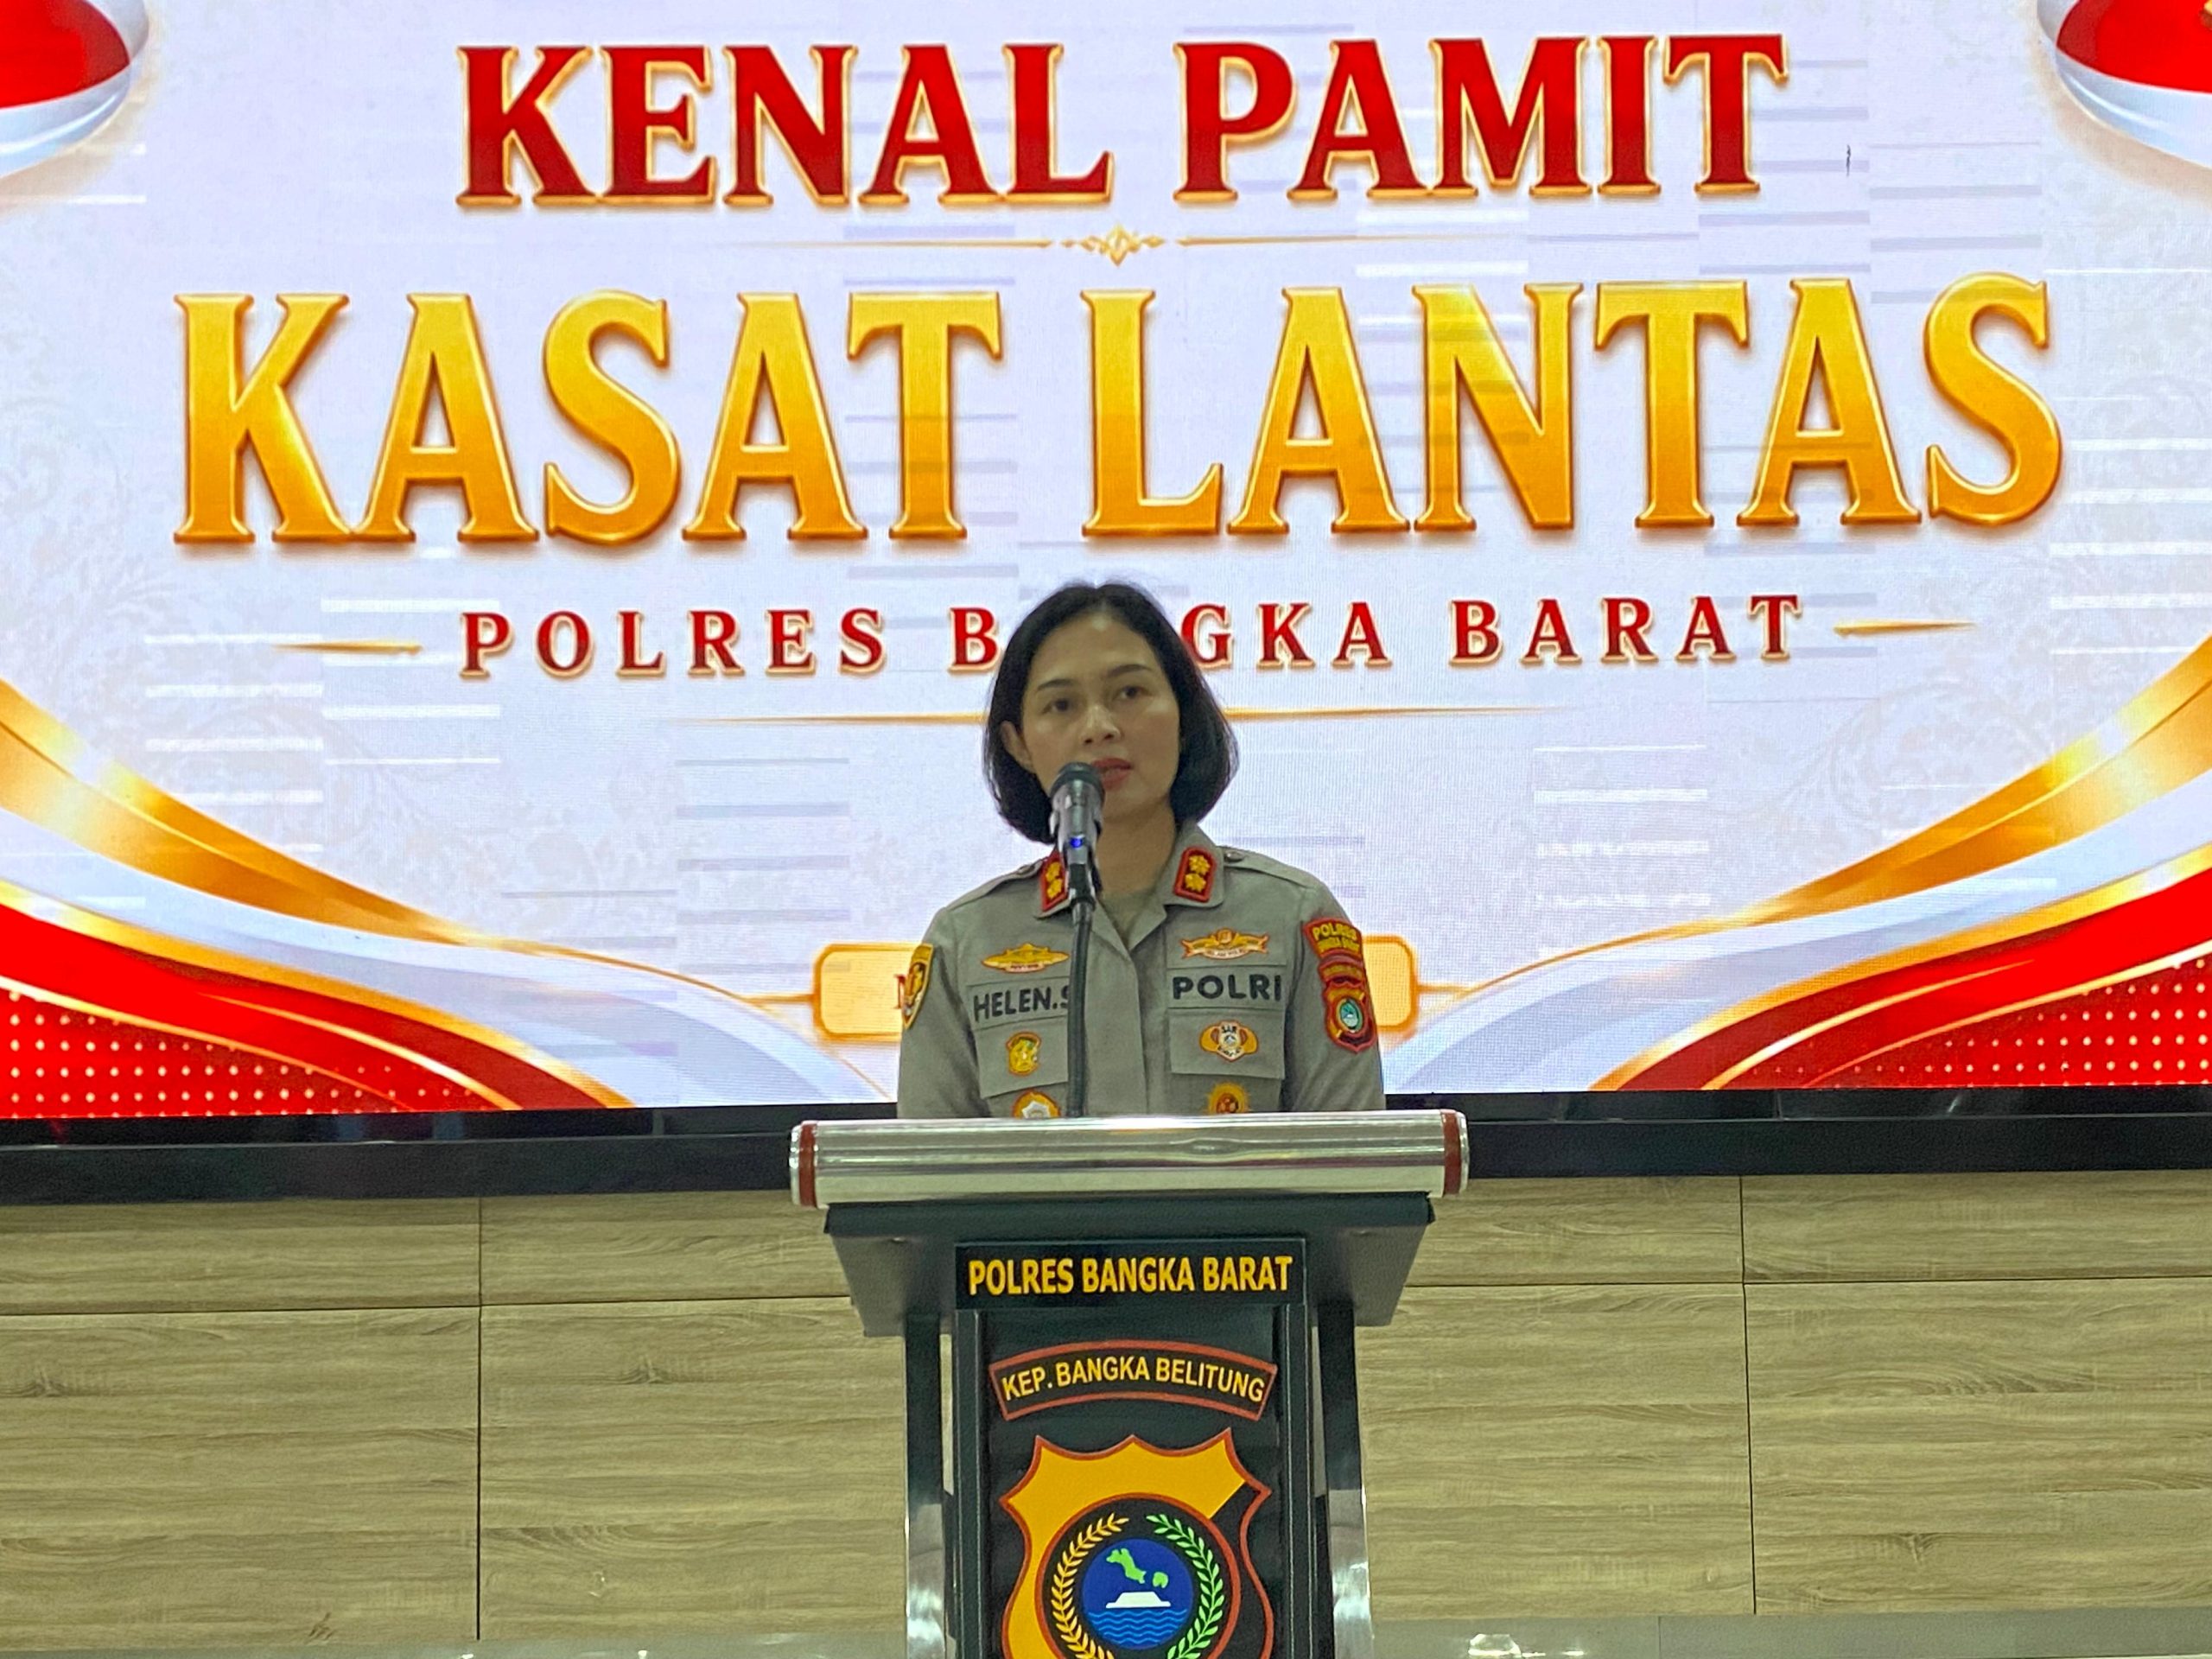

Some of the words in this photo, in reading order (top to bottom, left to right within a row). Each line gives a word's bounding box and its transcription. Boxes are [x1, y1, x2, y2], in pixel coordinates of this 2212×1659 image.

[456, 45, 1115, 207] KENAL
[1173, 35, 1789, 200] PAMIT
[174, 290, 1002, 545] KASAT
[1080, 272, 2063, 538] LANTAS
[461, 608, 886, 679] POLRES
[948, 602, 1392, 672] BGKA
[1449, 594, 1802, 667] BARAT
[1173, 974, 1281, 1001] POLRI
[969, 1258, 1074, 1295] POLRES
[1082, 1257, 1195, 1293] BANGKA
[1203, 1255, 1293, 1292] BARAT
[1002, 1366, 1052, 1401] KEP.
[1056, 1356, 1150, 1387] BANGKA
[1156, 1357, 1265, 1402] BELITUNG
